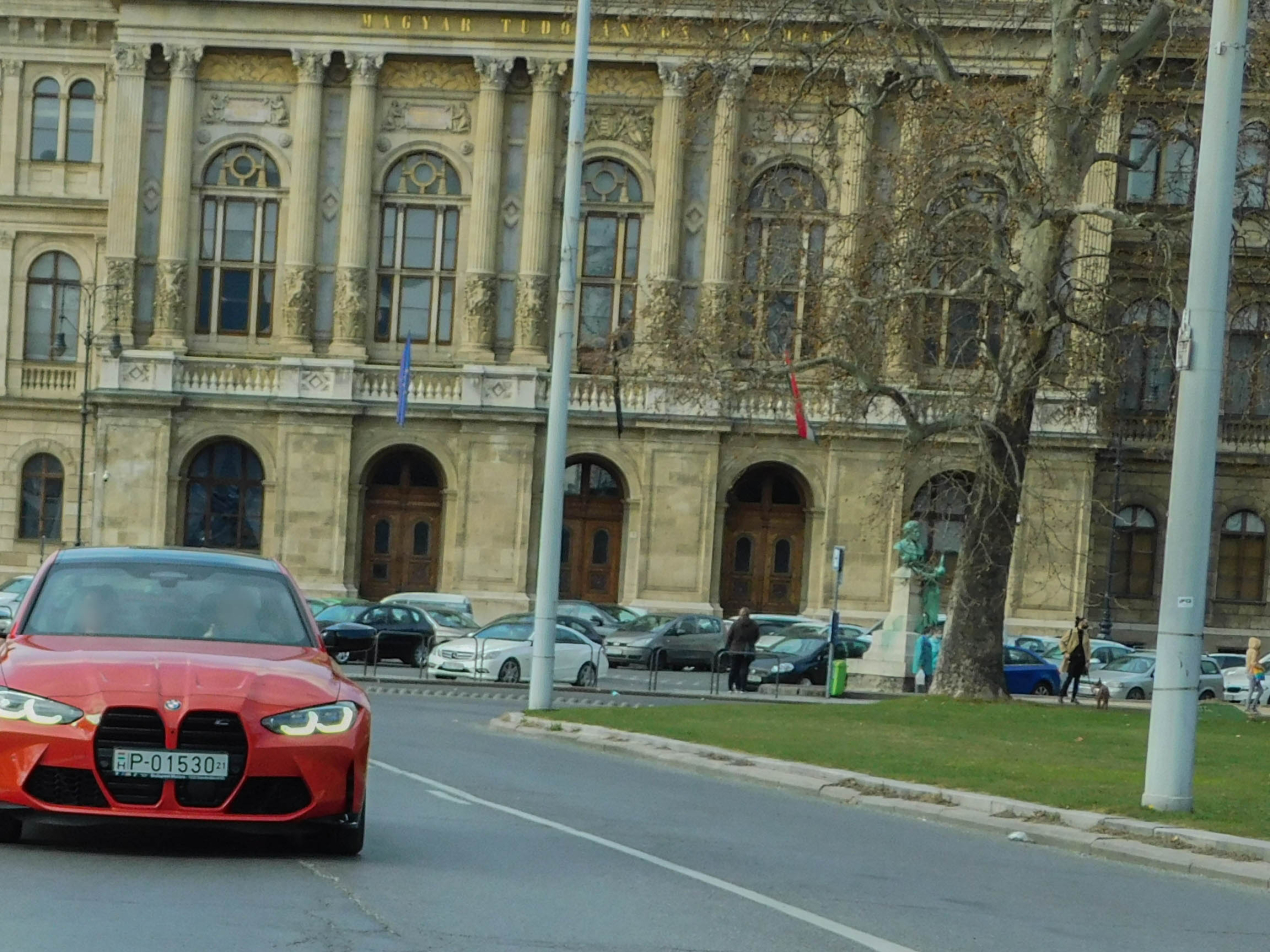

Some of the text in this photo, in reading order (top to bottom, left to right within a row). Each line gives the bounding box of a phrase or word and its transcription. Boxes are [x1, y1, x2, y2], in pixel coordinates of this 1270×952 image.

[361, 13, 472, 32] MAGYAR
[117, 753, 226, 774] H P-01530 21
